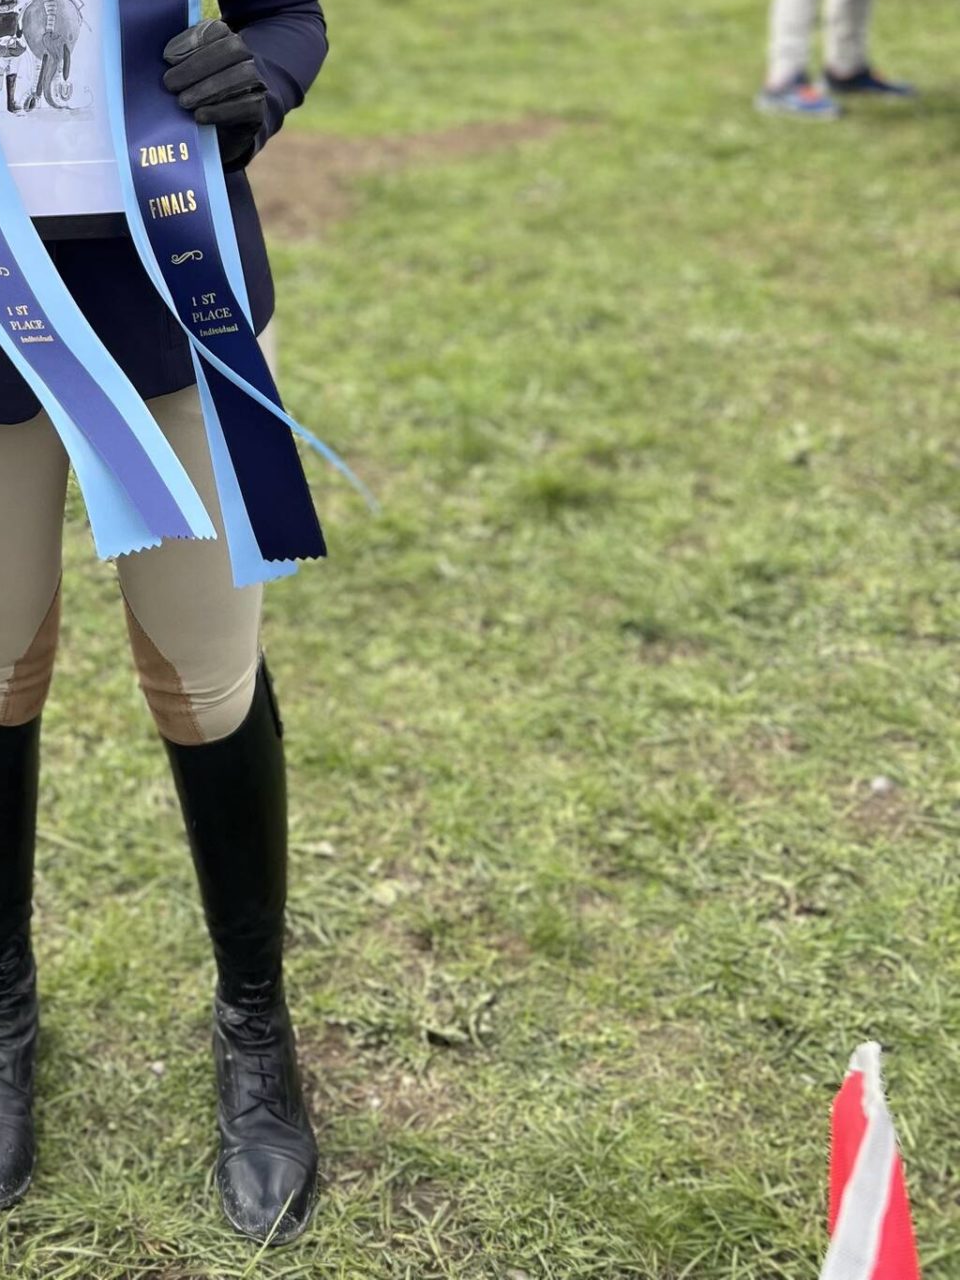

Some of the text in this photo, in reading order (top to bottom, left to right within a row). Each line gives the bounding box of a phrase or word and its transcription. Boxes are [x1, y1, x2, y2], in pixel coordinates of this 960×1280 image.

[140, 142, 190, 167] ZONE 9
[148, 189, 198, 219] FINALS
[192, 307, 233, 324] PLACE
[9, 319, 46, 331] PLACE
[199, 323, 239, 337] Individual
